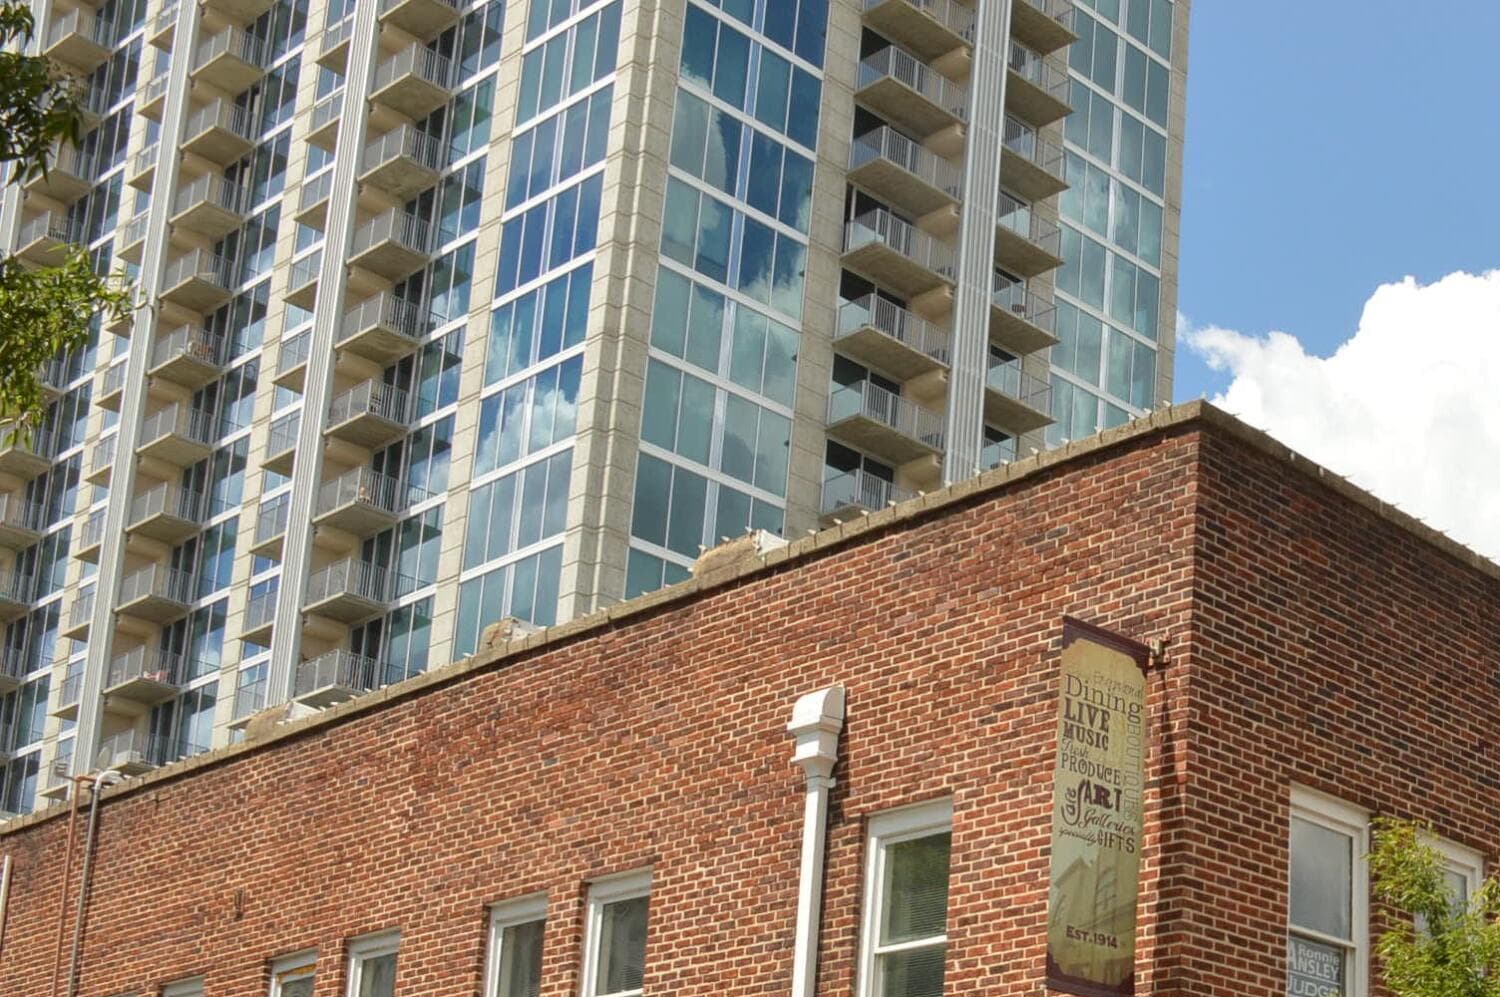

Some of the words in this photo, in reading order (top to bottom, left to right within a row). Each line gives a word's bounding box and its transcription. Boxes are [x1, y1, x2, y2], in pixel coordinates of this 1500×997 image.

[1064, 697, 1110, 733] LIVE
[1065, 673, 1143, 724] Dining
[1063, 720, 1109, 752] MUSIC
[1061, 752, 1121, 786] PRODUCE
[1123, 723, 1141, 822] BOUTIQUES
[1083, 779, 1122, 812] ART
[1078, 808, 1135, 836] Galleries
[1096, 829, 1135, 854] GIFTS
[1298, 943, 1340, 966] Ronnie
